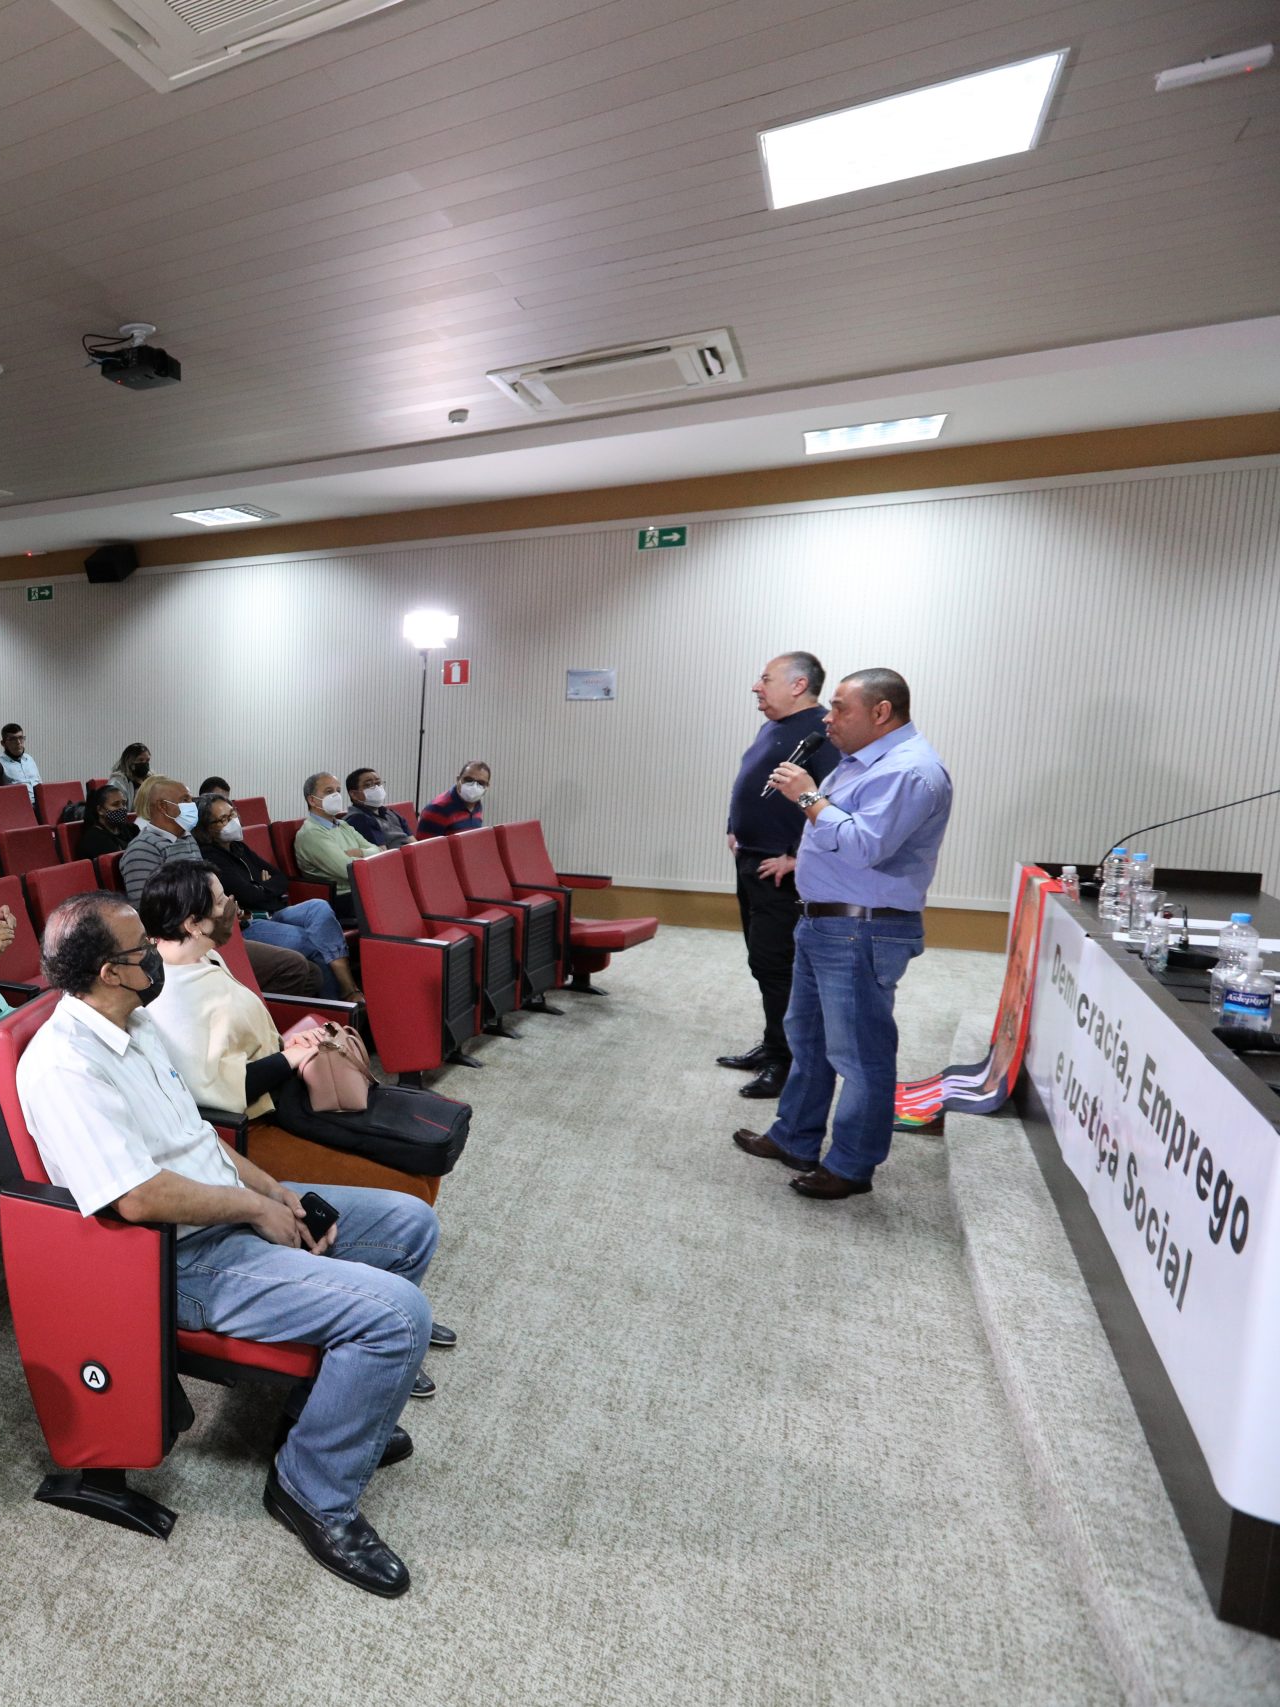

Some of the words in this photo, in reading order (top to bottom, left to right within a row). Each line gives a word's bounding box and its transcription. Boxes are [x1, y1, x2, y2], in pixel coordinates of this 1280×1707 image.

[1051, 944, 1132, 1102] Demcracia,
[1138, 1053, 1249, 1254] Emprego
[1055, 1051, 1065, 1084] e
[1064, 1059, 1119, 1183] Justiça
[1123, 1152, 1193, 1313] Social
[88, 1370, 101, 1385] A
